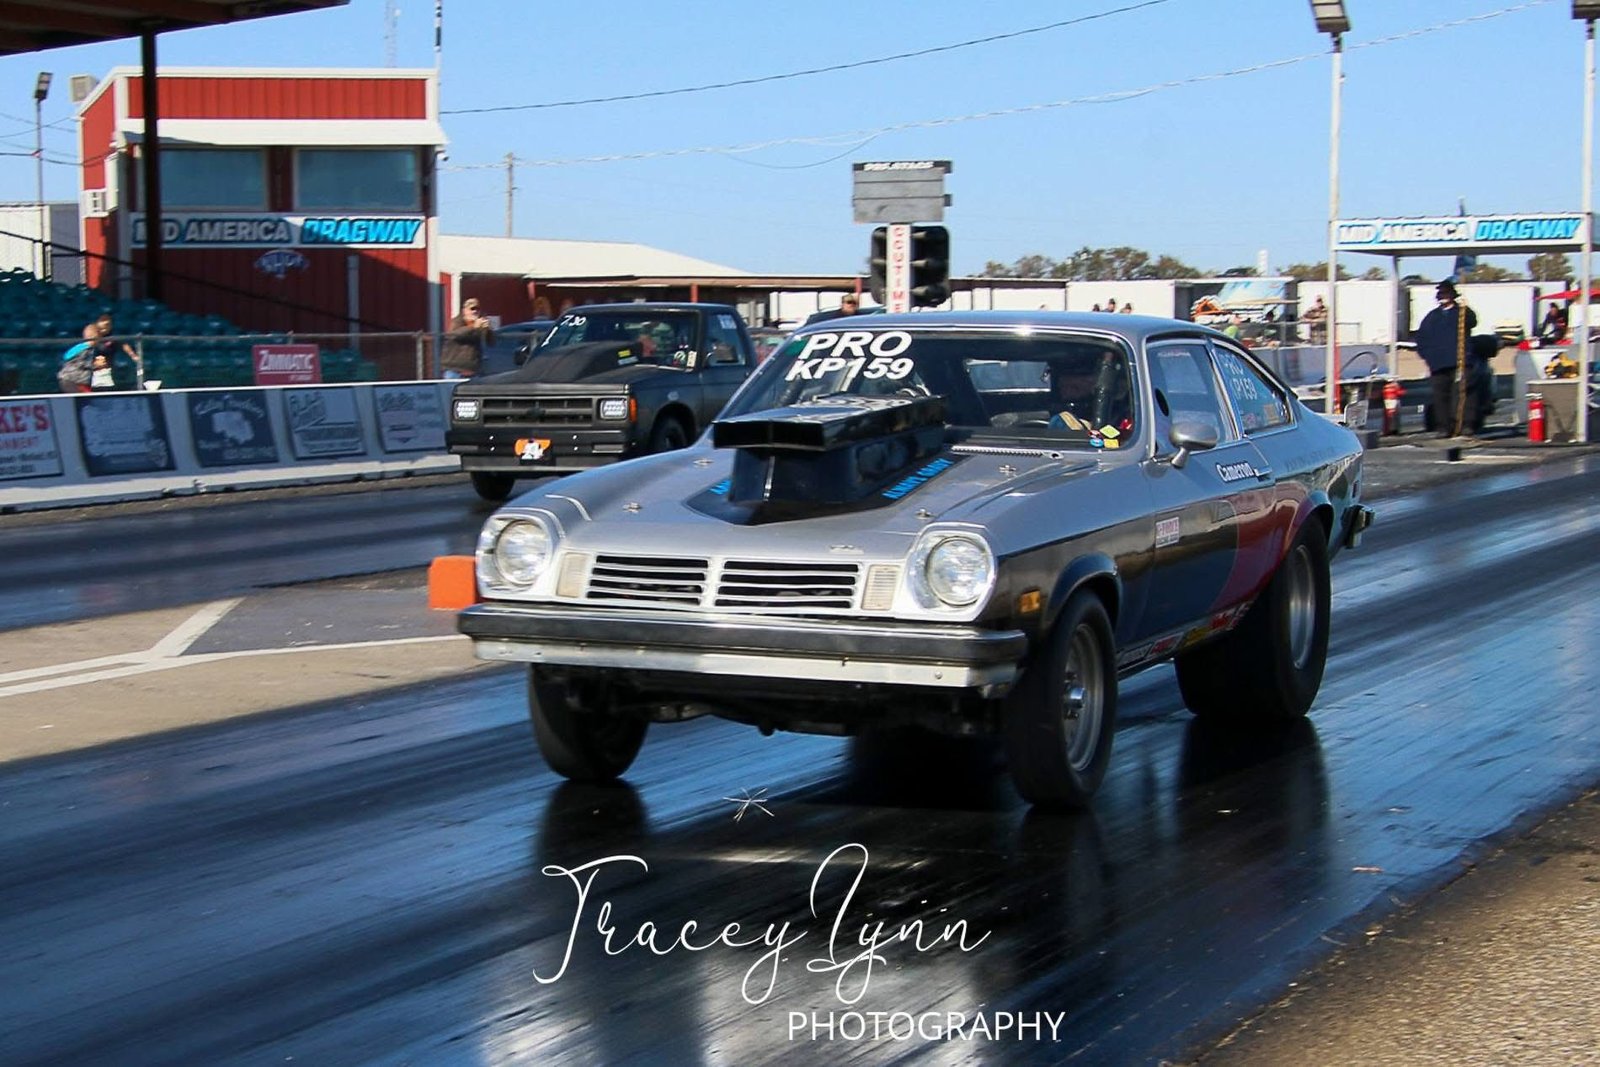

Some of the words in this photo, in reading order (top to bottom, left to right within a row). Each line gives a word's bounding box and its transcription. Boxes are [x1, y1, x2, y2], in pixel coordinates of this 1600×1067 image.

[184, 219, 292, 244] AMERICA
[302, 218, 421, 244] DRAGWAY
[1338, 224, 1375, 244] MID
[1377, 221, 1470, 243] AMERICA
[1473, 218, 1581, 242] DRAGWAY
[798, 331, 912, 359] PRO
[785, 357, 914, 381] KP159
[1216, 461, 1255, 482] Cameron
